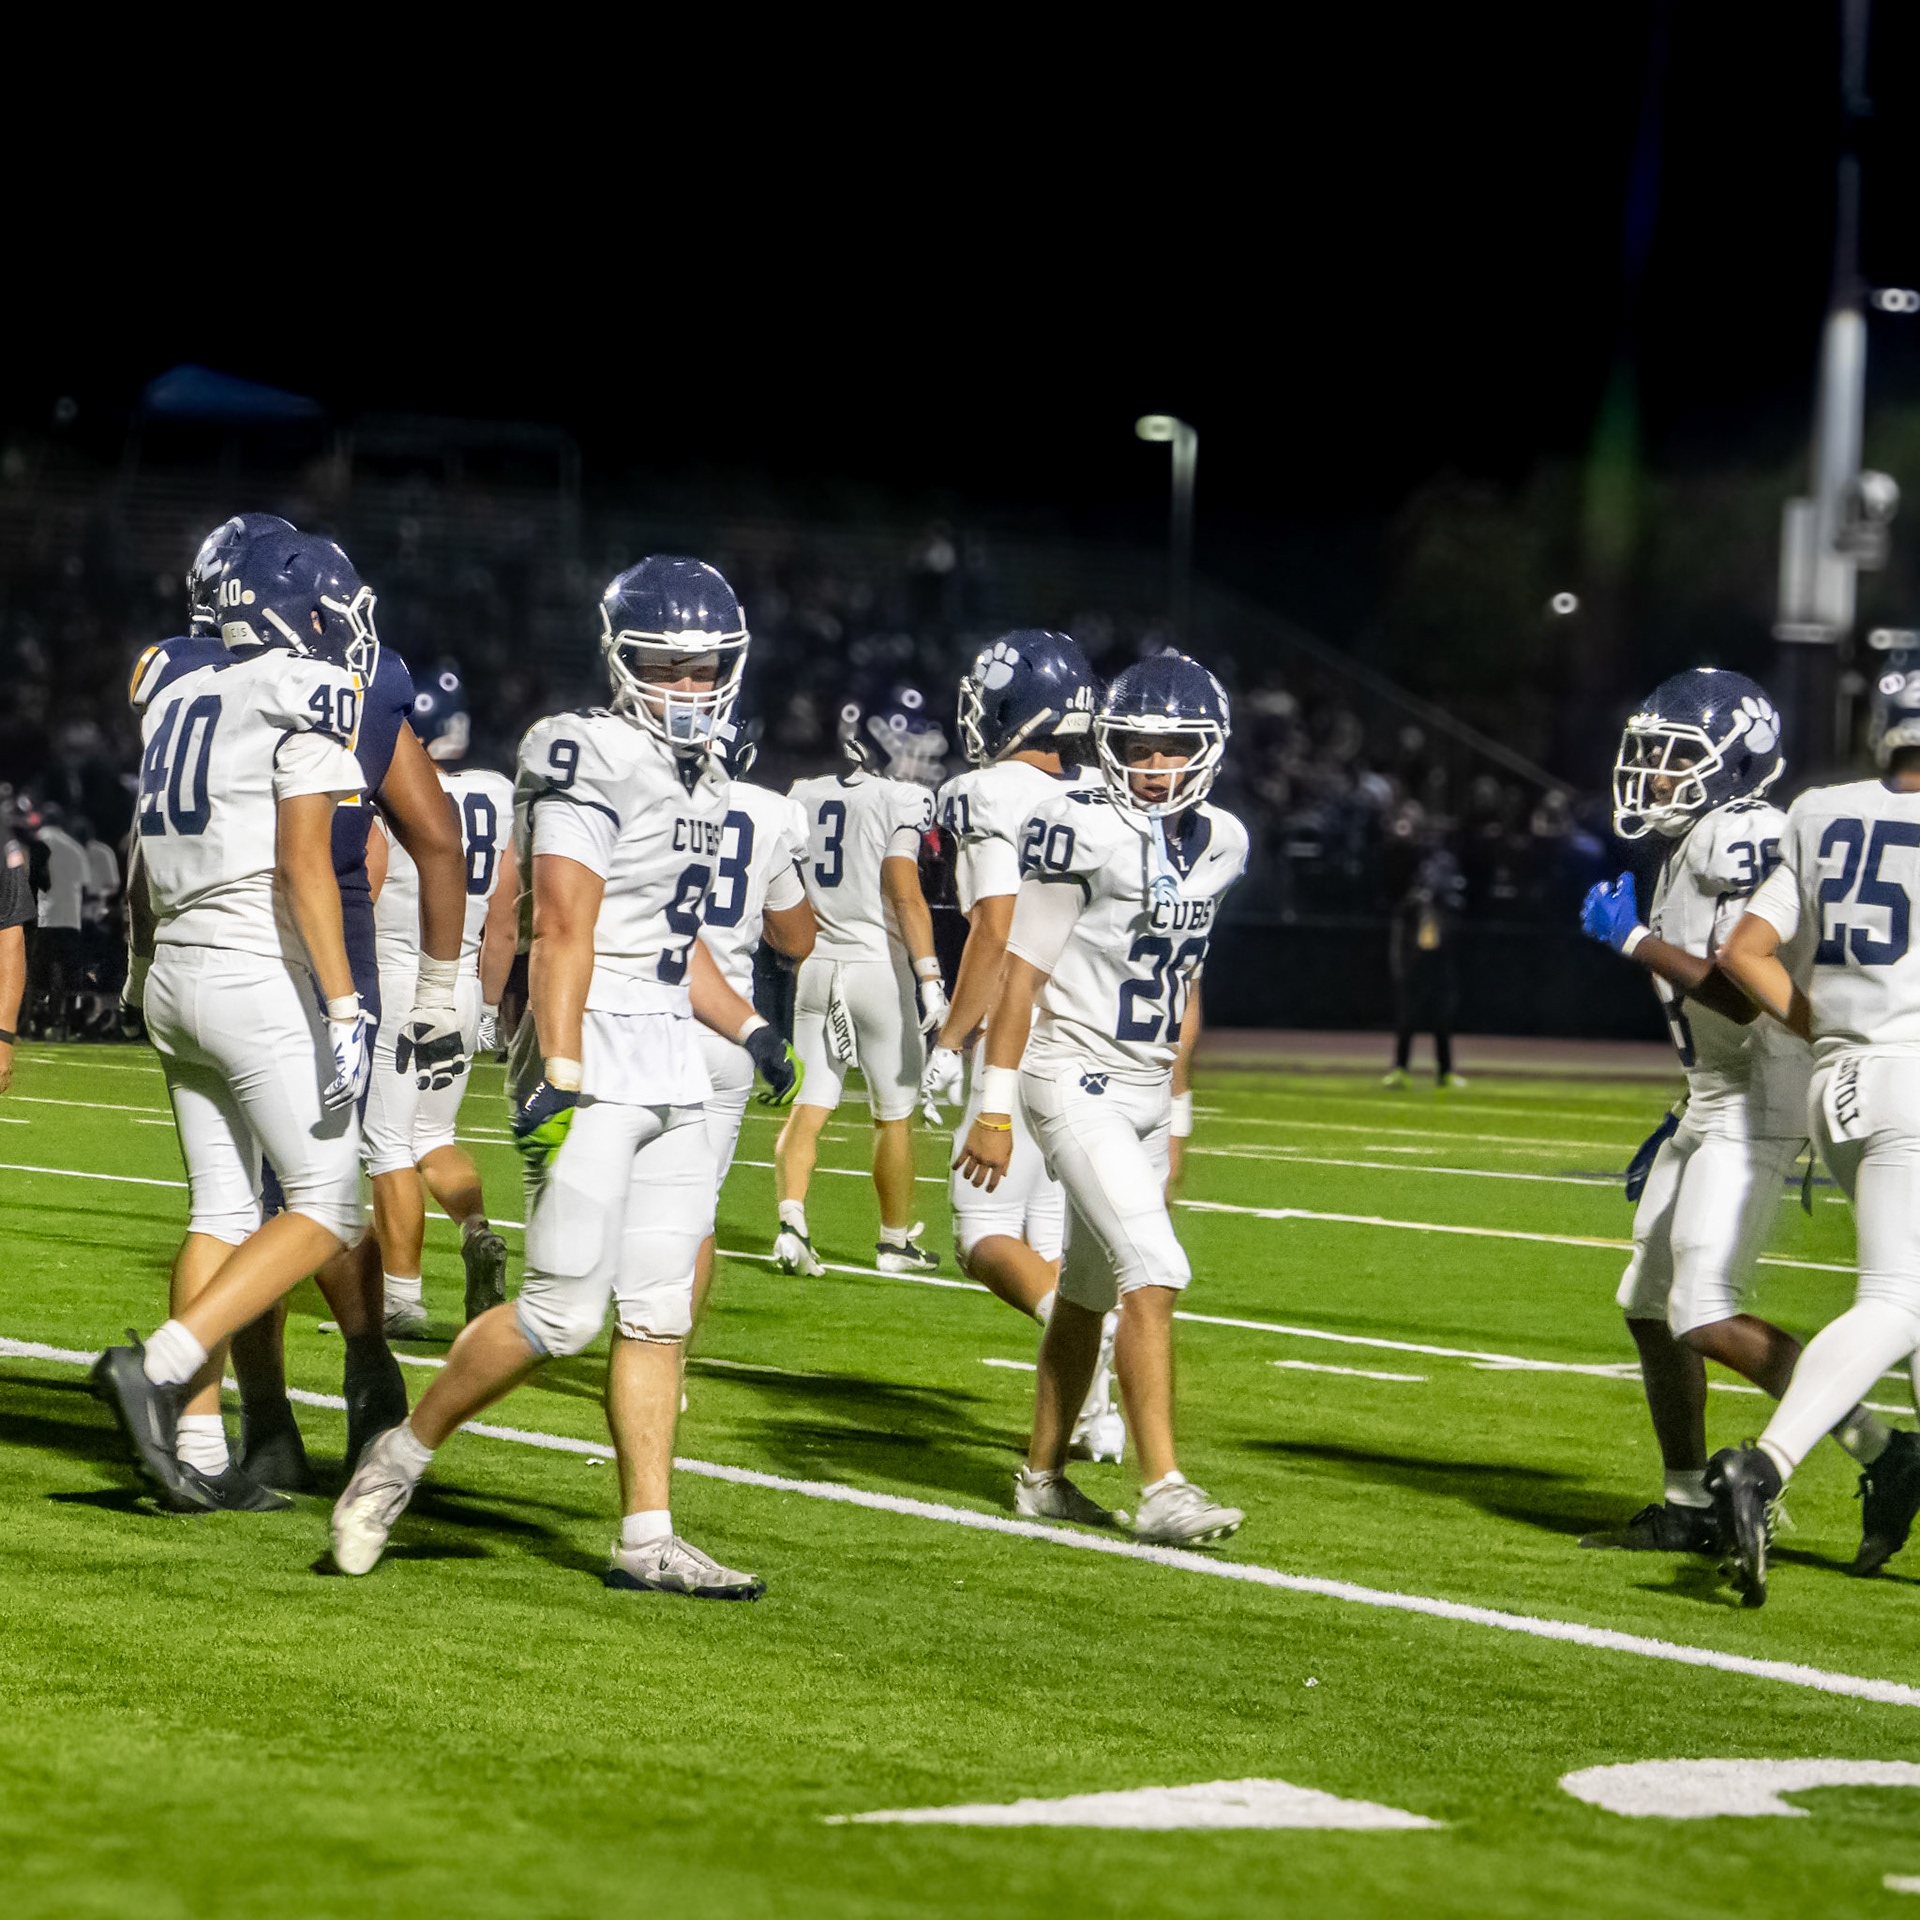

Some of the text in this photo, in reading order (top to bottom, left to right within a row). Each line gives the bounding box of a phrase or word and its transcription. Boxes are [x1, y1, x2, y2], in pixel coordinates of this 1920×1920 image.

[308, 684, 357, 736] 40
[140, 694, 222, 837] 40
[546, 738, 580, 790] 9
[444, 791, 498, 895] 8
[814, 799, 847, 888] 3
[923, 797, 933, 827] 3
[943, 793, 975, 834] 41
[1023, 817, 1076, 872] 20
[704, 809, 756, 928] 3
[1814, 817, 1920, 966] 25
[656, 863, 711, 986] 9
[1150, 899, 1211, 931] CUBS
[1115, 935, 1208, 1043] 20
